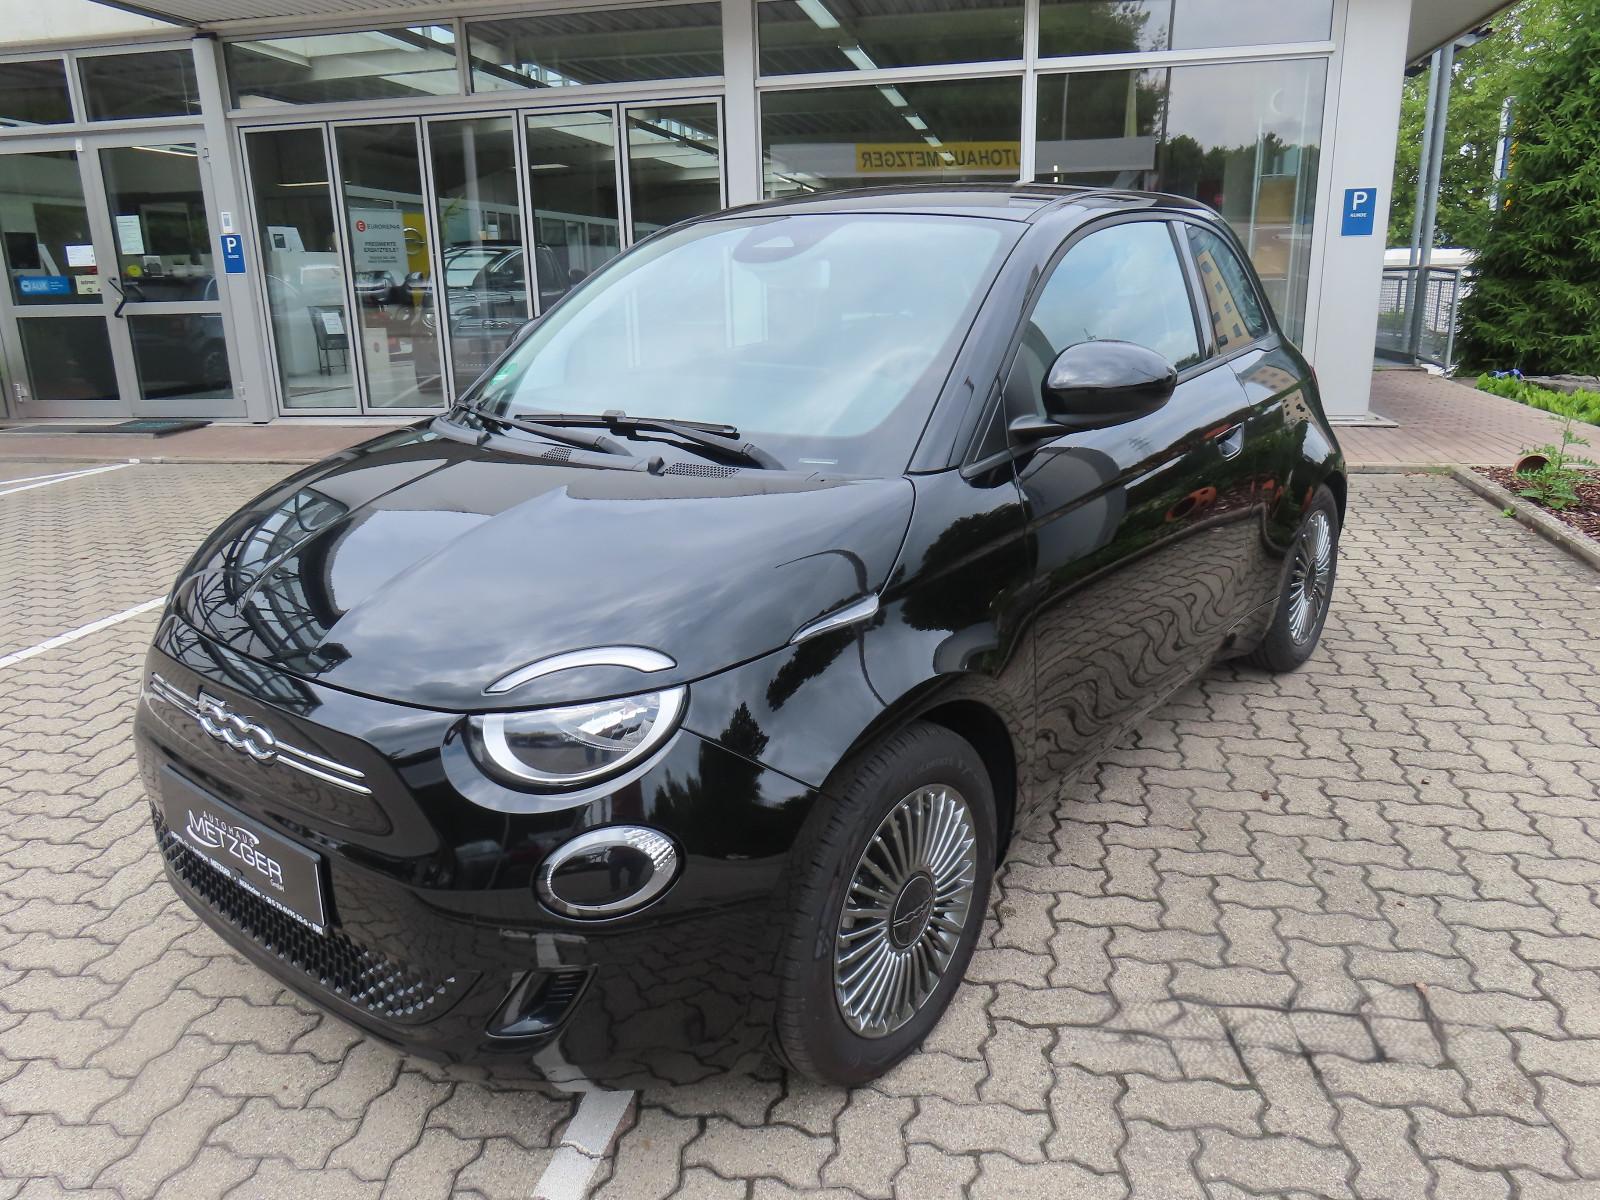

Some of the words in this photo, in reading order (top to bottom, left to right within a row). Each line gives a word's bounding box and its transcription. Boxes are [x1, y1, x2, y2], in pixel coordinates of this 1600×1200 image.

[1352, 191, 1368, 211] P
[226, 237, 237, 253] P
[199, 692, 276, 761] 500
[188, 809, 284, 885] METZGER
[203, 810, 256, 848] AUTOHAUS
